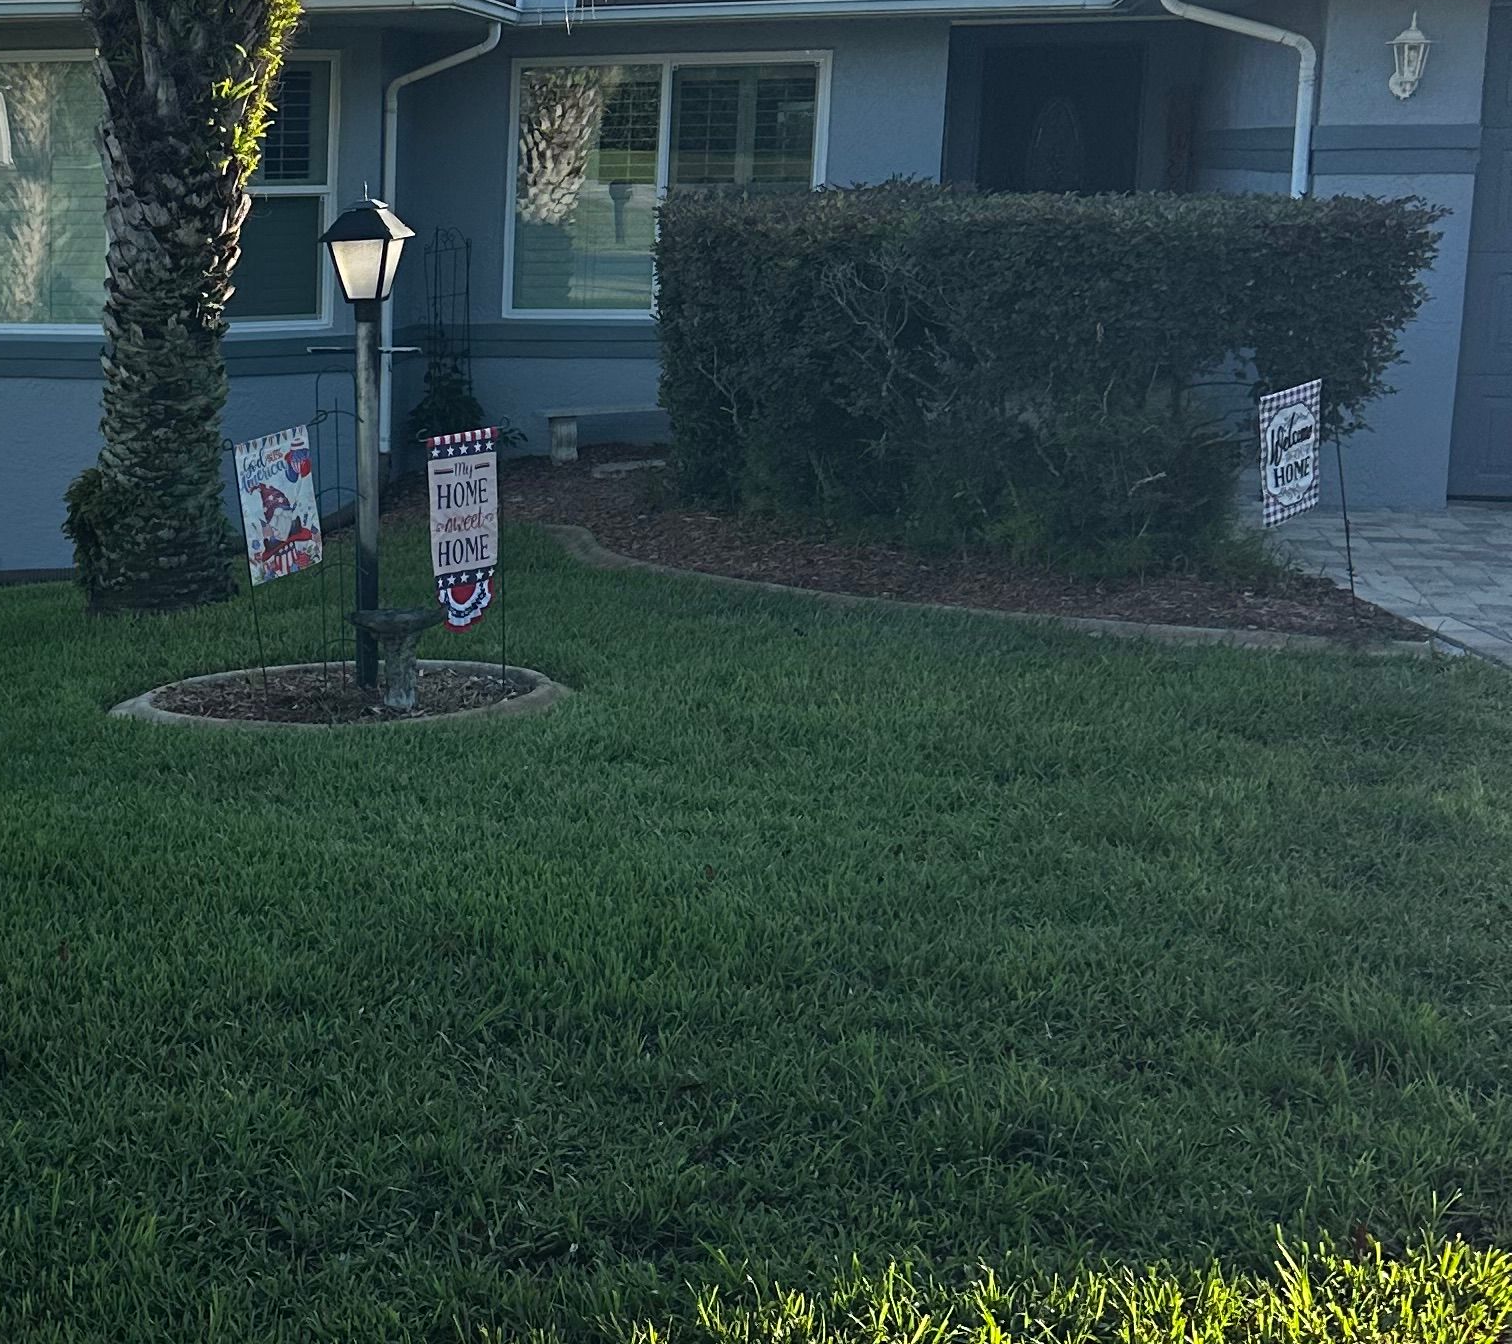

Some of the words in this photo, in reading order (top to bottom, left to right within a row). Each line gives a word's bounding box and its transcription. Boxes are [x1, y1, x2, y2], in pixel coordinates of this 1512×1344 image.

[243, 448, 266, 478] God
[454, 462, 473, 479] My
[1274, 456, 1310, 488] HOME
[437, 477, 488, 510] HOME
[444, 506, 485, 533] sweet
[438, 534, 490, 567] HOME
